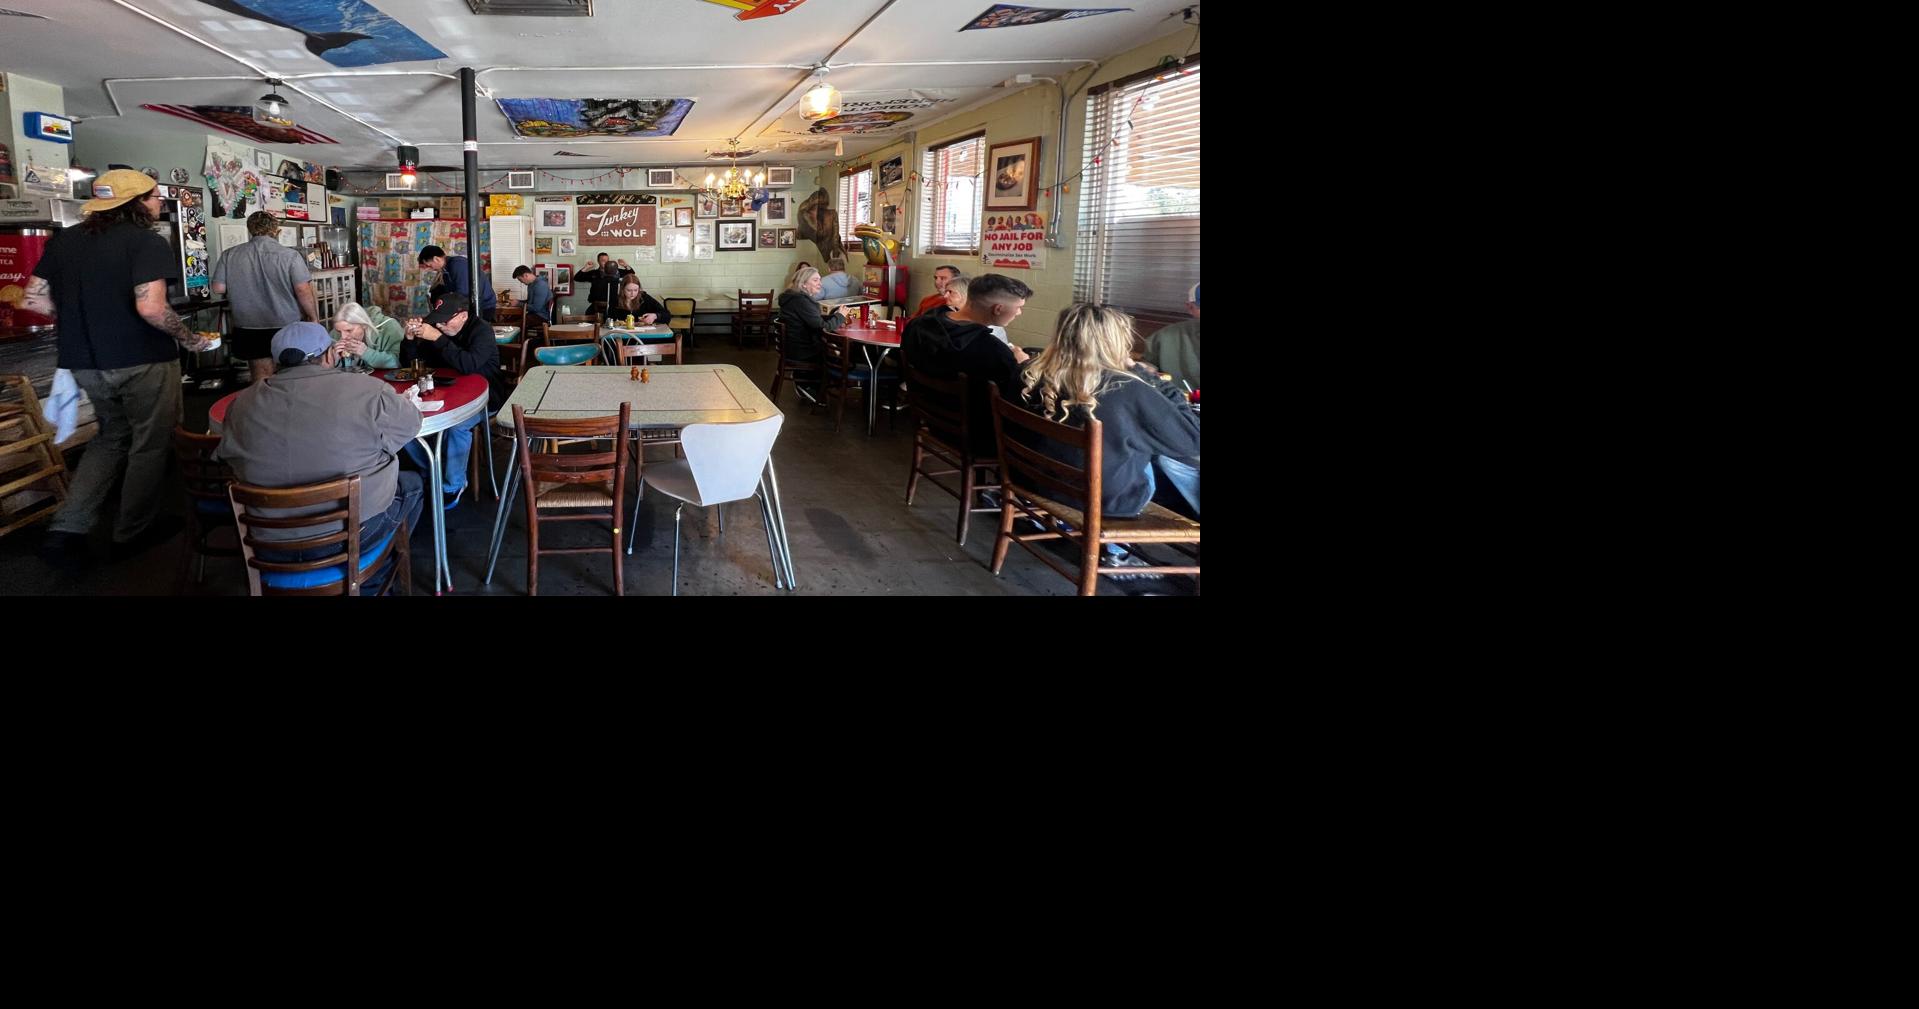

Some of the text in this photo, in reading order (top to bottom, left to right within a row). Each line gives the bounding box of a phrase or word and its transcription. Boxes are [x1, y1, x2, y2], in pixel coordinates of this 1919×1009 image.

[587, 206, 639, 236] Turkey
[610, 229, 647, 237] WOLF
[999, 232, 1019, 240] JAIL
[1021, 232, 1043, 240] FOR
[992, 243, 1033, 251] ANY JOB
